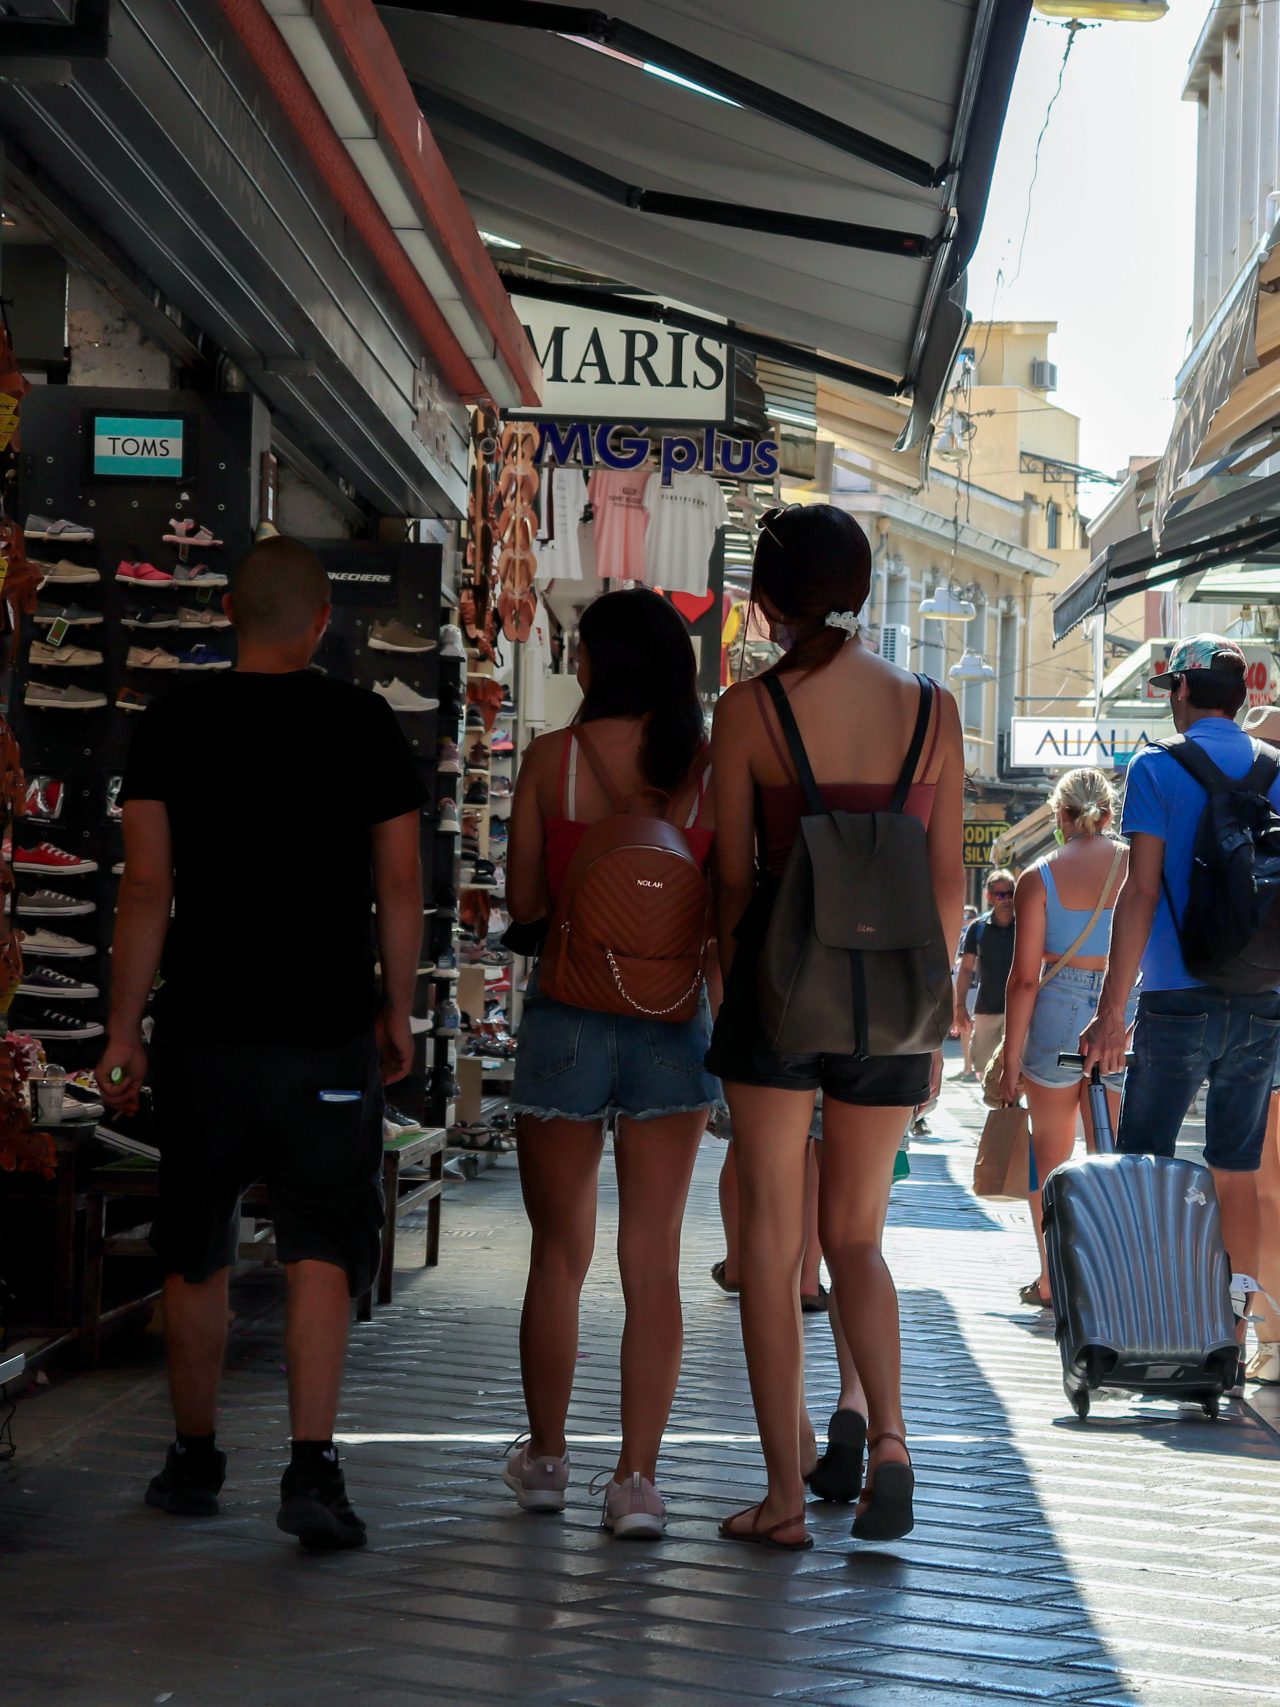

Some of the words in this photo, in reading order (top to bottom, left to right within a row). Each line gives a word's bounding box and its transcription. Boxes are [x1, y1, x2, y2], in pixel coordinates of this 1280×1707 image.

[107, 437, 170, 457] TOMS
[536, 424, 650, 470] MG
[661, 427, 780, 488] plus
